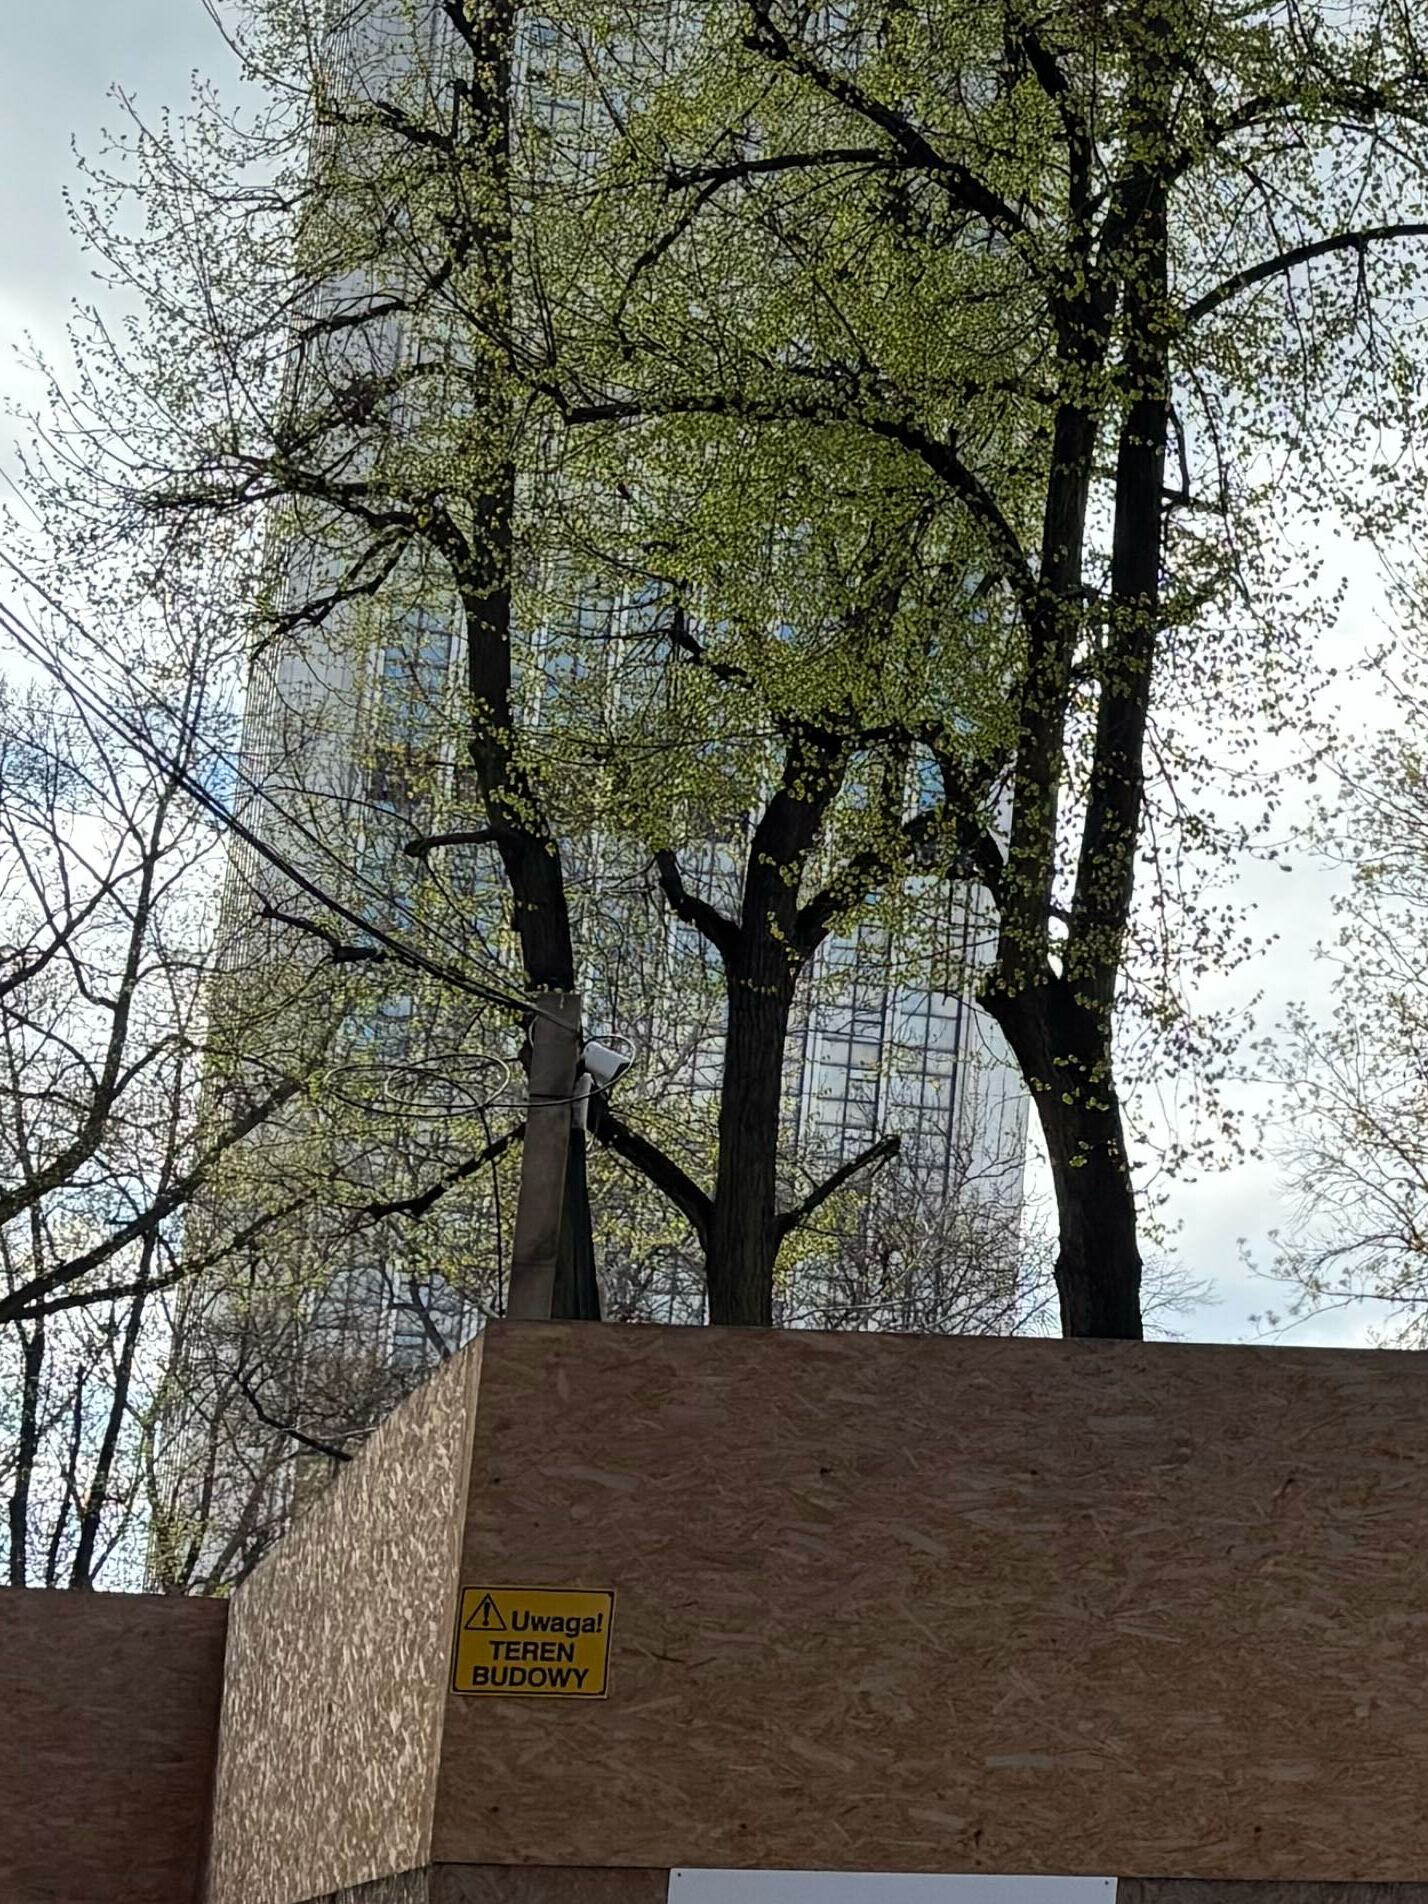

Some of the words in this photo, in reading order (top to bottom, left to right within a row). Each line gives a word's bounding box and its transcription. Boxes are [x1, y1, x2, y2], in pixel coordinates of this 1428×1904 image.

[511, 1610, 603, 1638] Uwaga!
[489, 1641, 574, 1662] TEREN
[472, 1666, 589, 1688] BUDOWY
